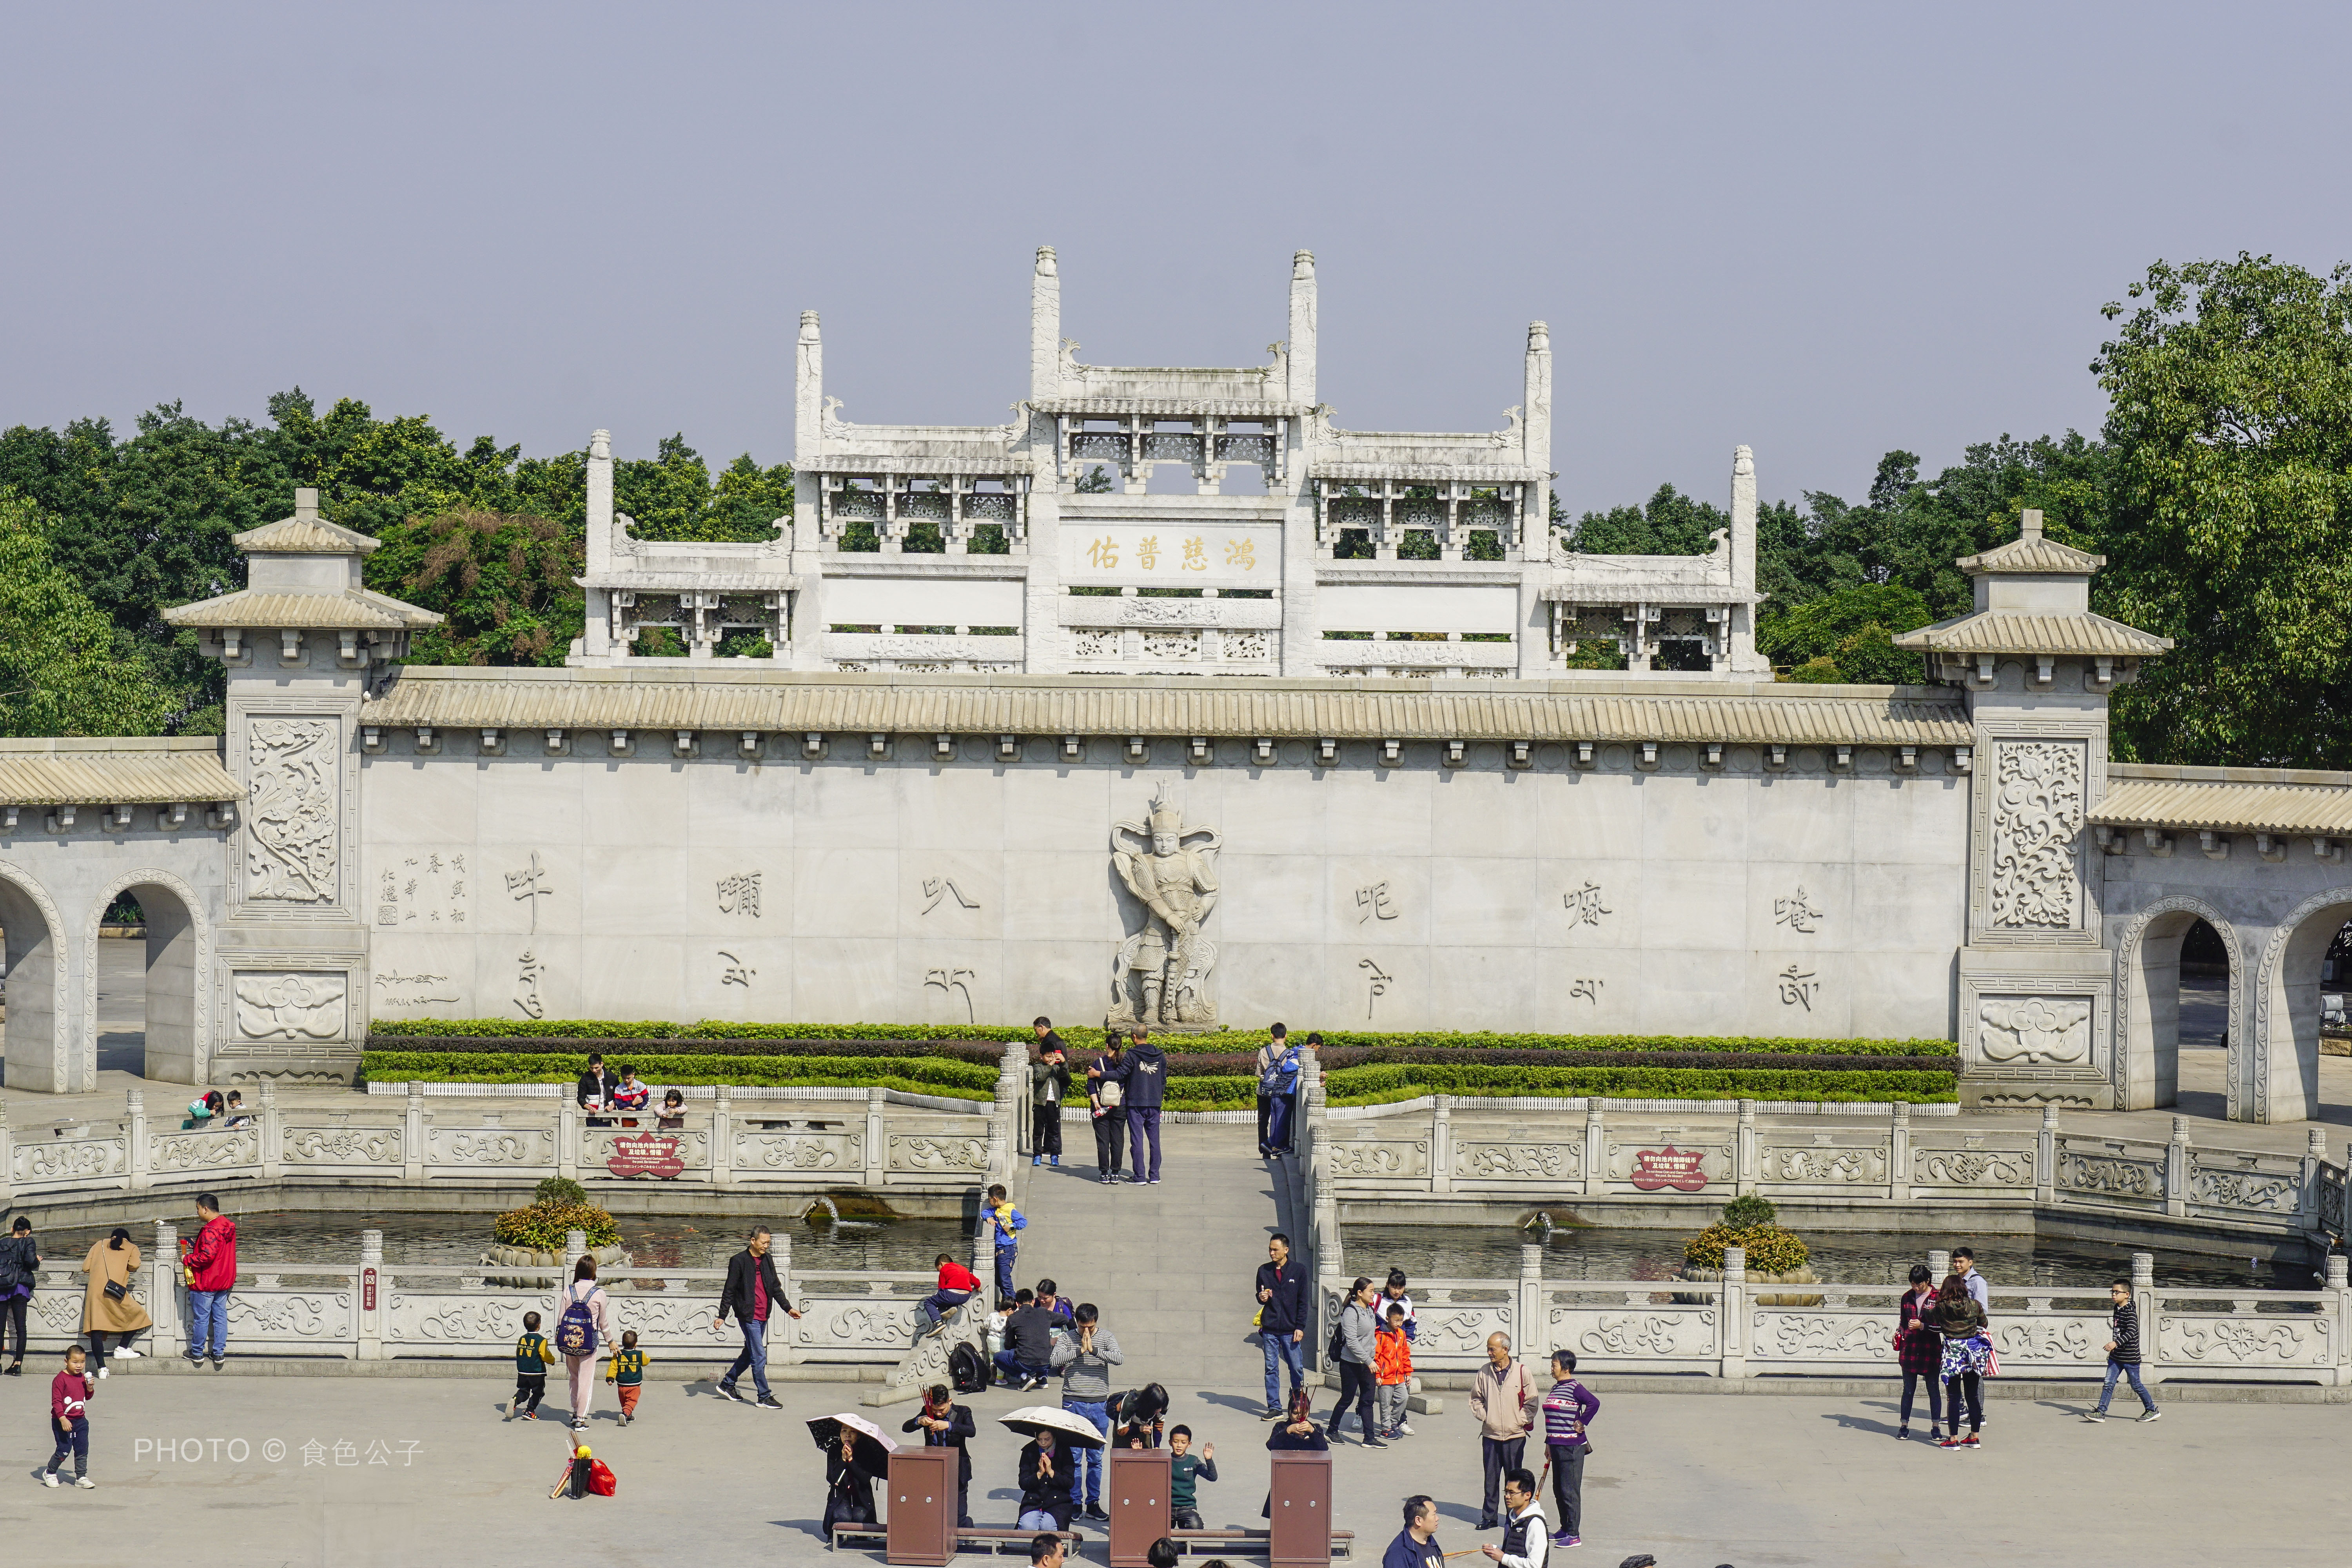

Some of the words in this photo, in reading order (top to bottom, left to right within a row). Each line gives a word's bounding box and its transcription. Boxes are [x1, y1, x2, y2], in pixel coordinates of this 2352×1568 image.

[505, 849, 553, 935] 吽
[922, 877, 980, 915] 叭
[1356, 880, 1399, 924] 呢
